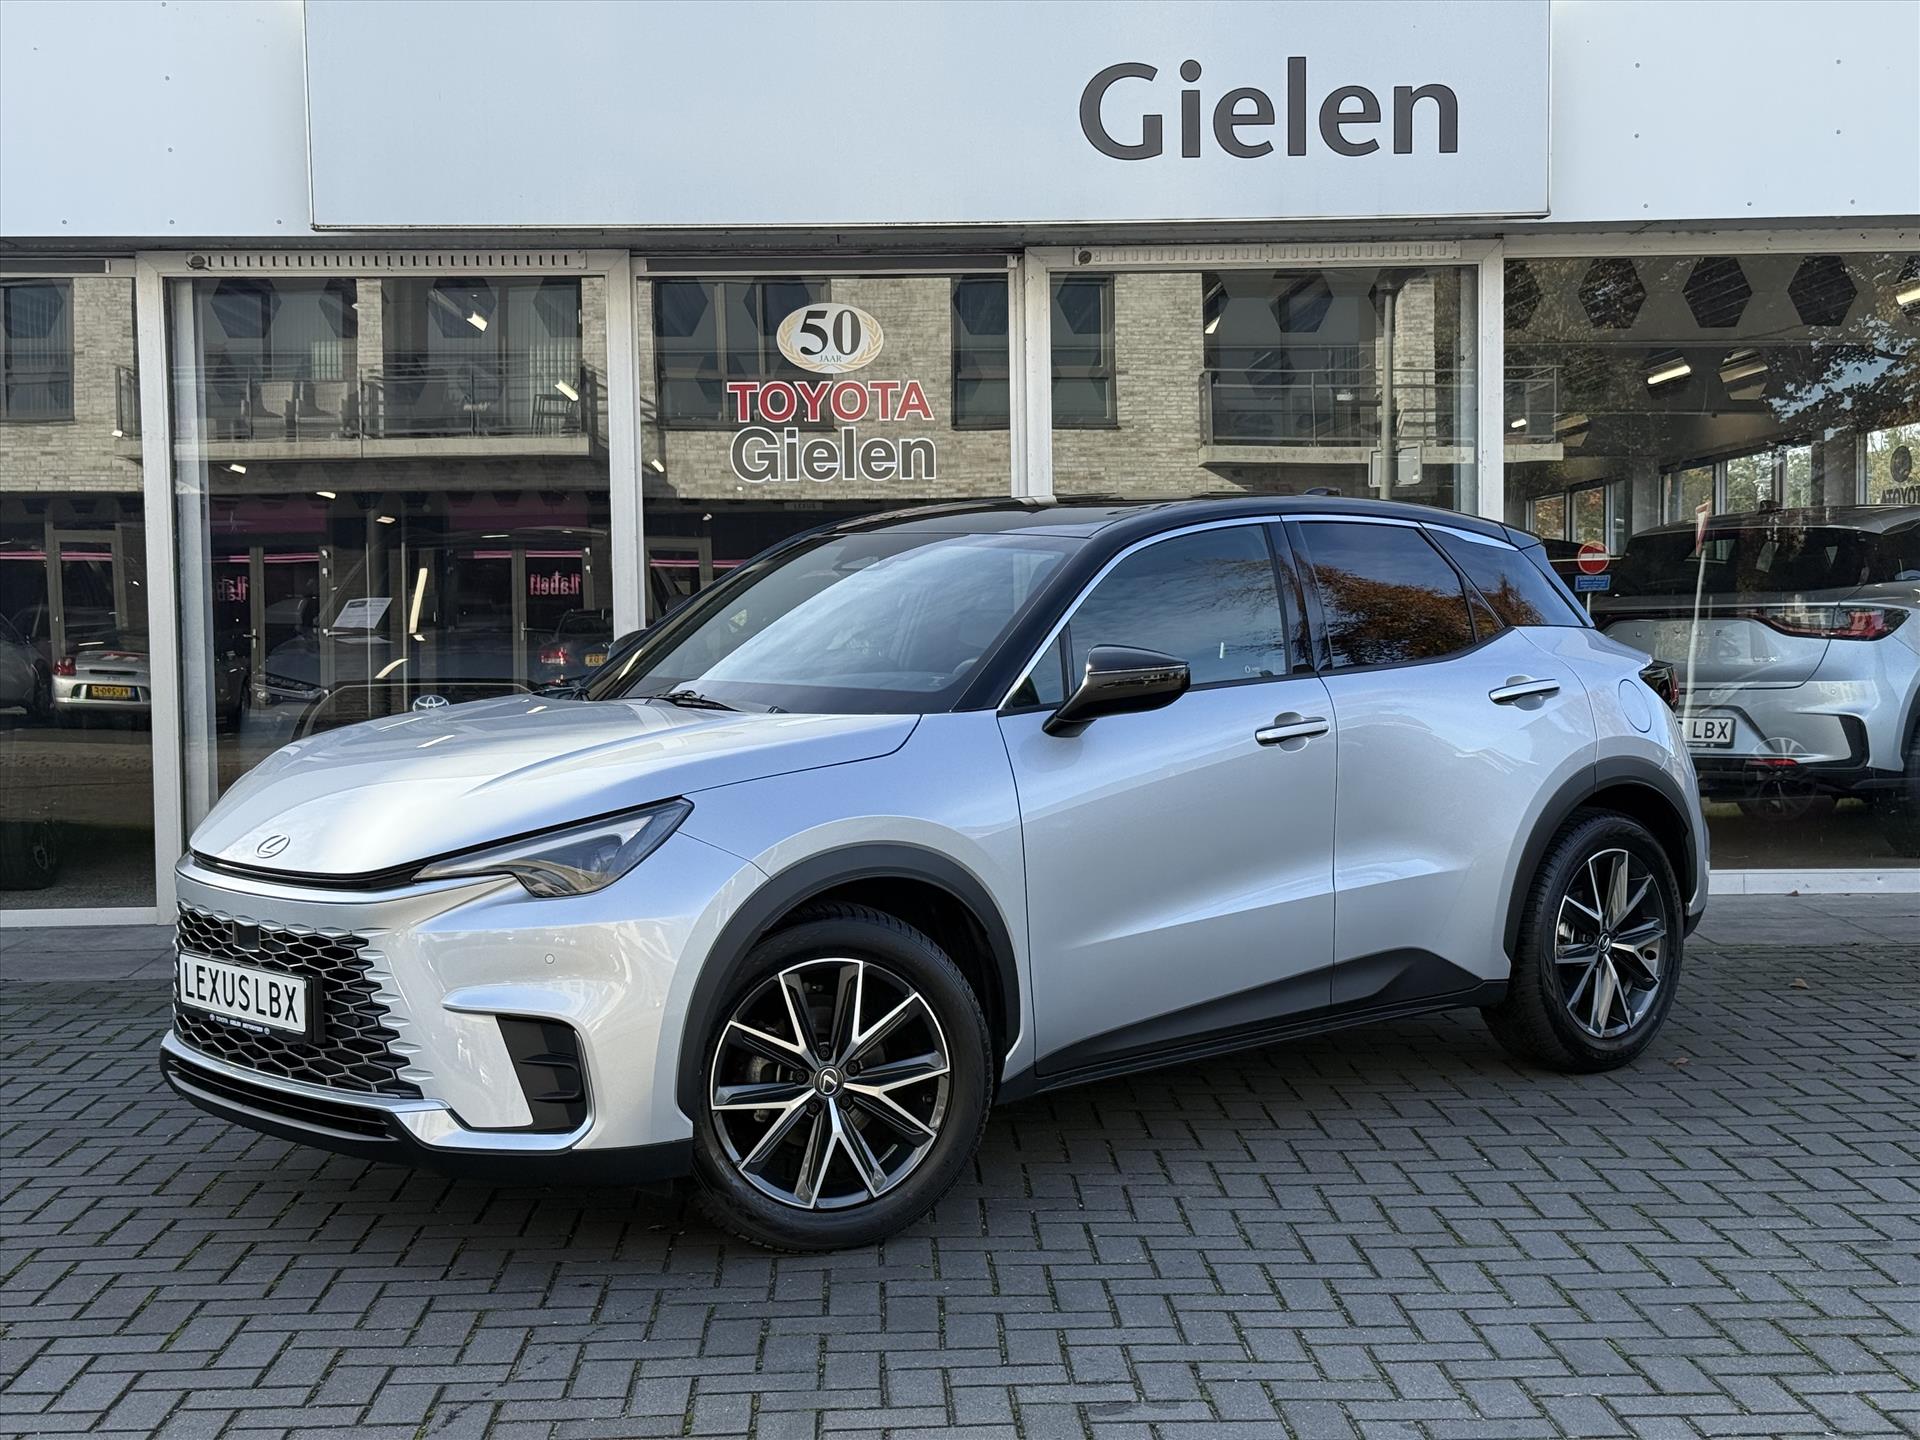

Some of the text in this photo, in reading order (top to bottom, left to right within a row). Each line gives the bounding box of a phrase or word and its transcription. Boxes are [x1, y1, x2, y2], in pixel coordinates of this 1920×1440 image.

[1079, 56, 1458, 161] Gielen
[799, 309, 862, 356] 50
[819, 354, 842, 363] JAAR
[727, 380, 935, 423] TOYOTA
[730, 426, 937, 483] Gielen
